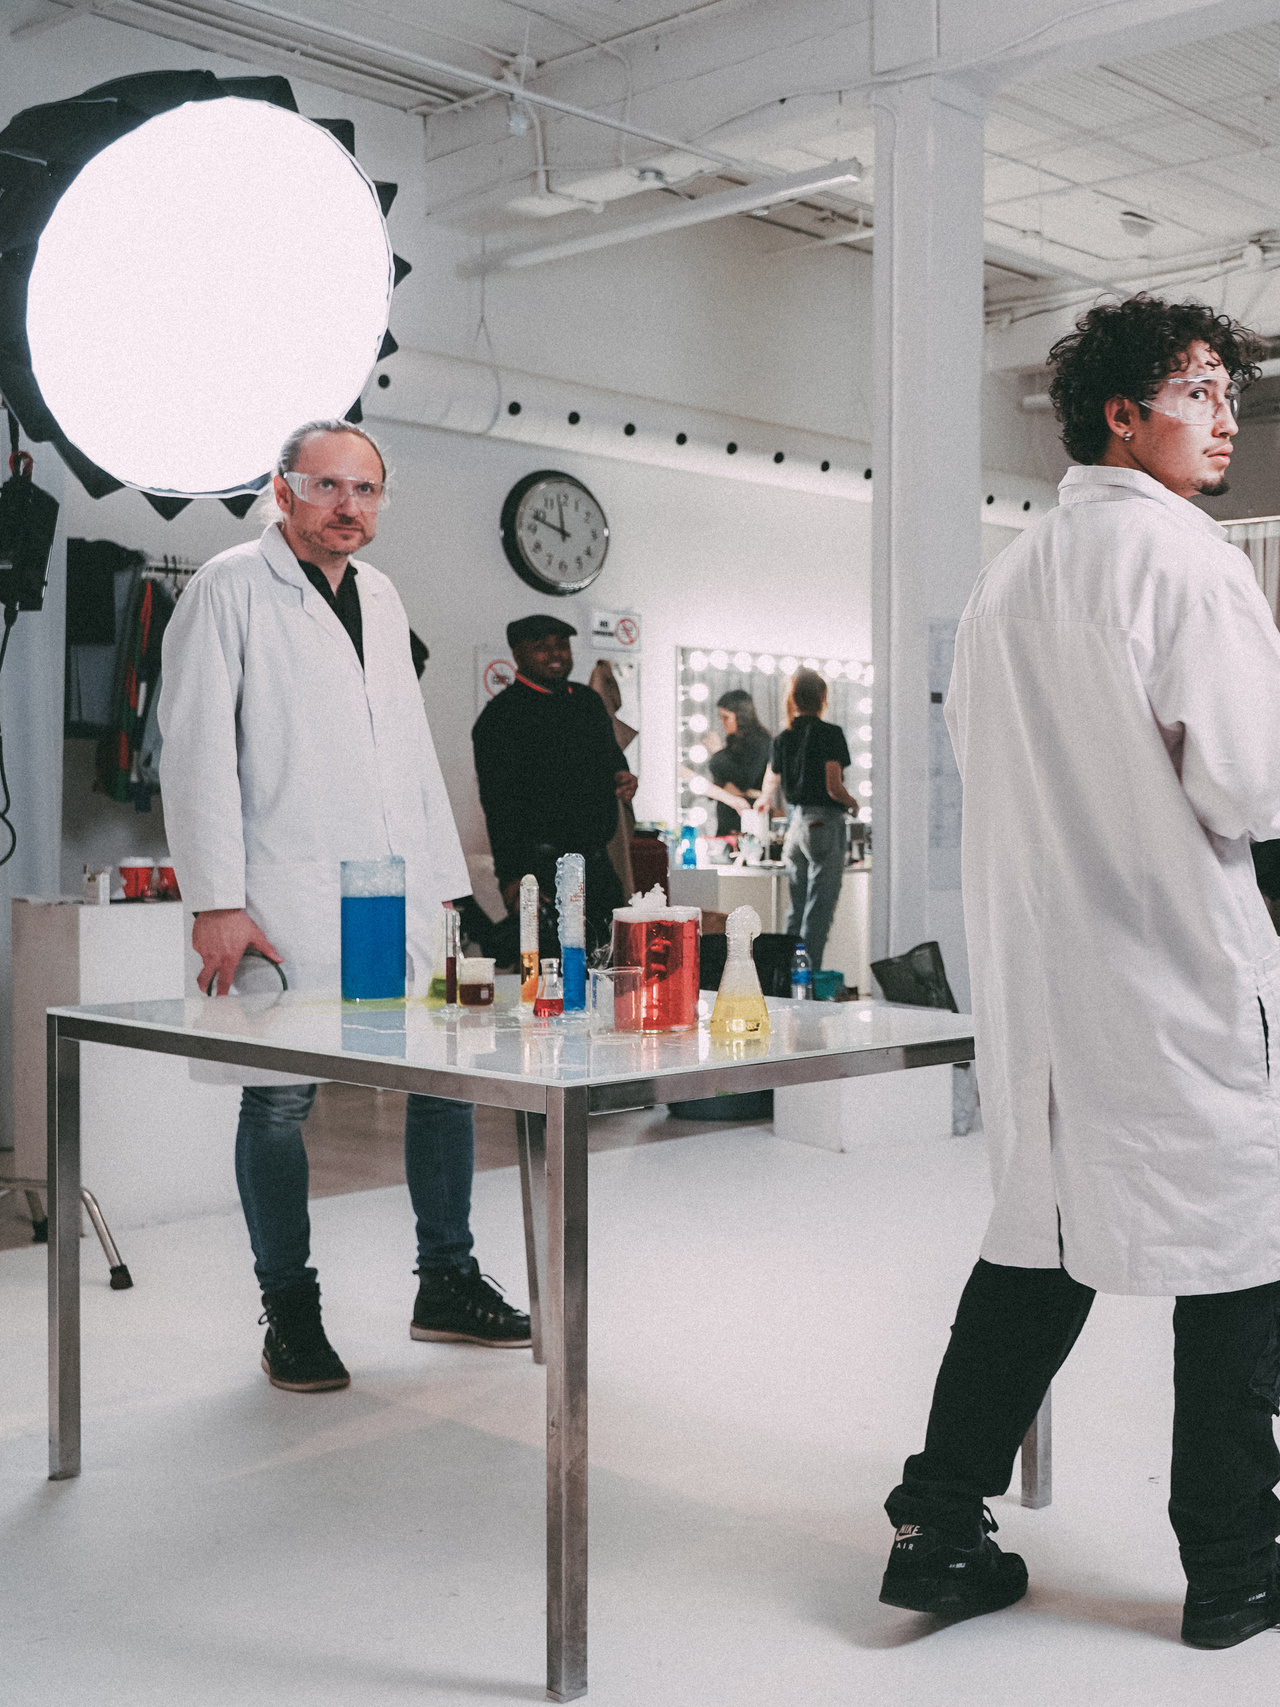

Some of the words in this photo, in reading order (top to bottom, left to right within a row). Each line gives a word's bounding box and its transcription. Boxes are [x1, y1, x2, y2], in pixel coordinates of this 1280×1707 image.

[543, 497, 555, 510] 11
[558, 560, 569, 574] 6
[900, 1524, 921, 1534] NIKE
[896, 1542, 914, 1550] AIR
